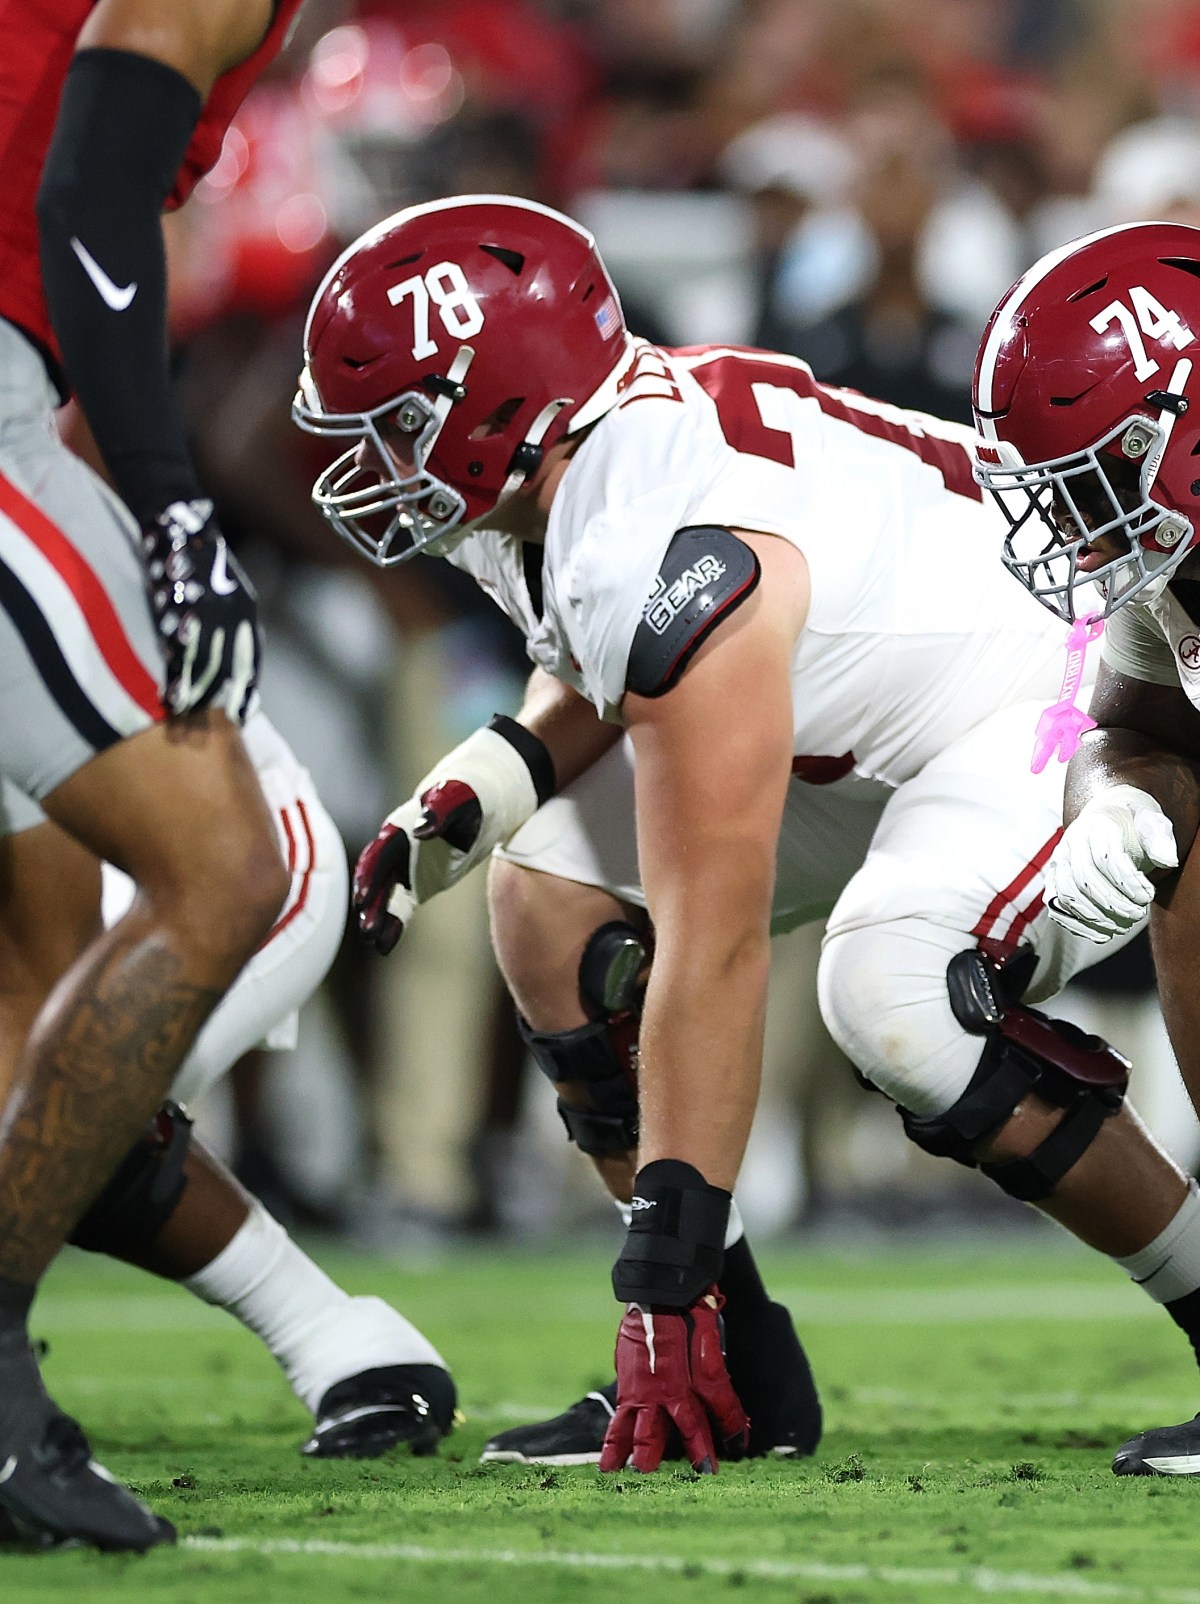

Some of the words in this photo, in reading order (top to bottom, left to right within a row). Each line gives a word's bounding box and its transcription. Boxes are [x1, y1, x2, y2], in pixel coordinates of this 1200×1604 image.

[386, 261, 485, 361] 78
[1088, 285, 1196, 383] 74
[645, 555, 727, 636] GEAR
